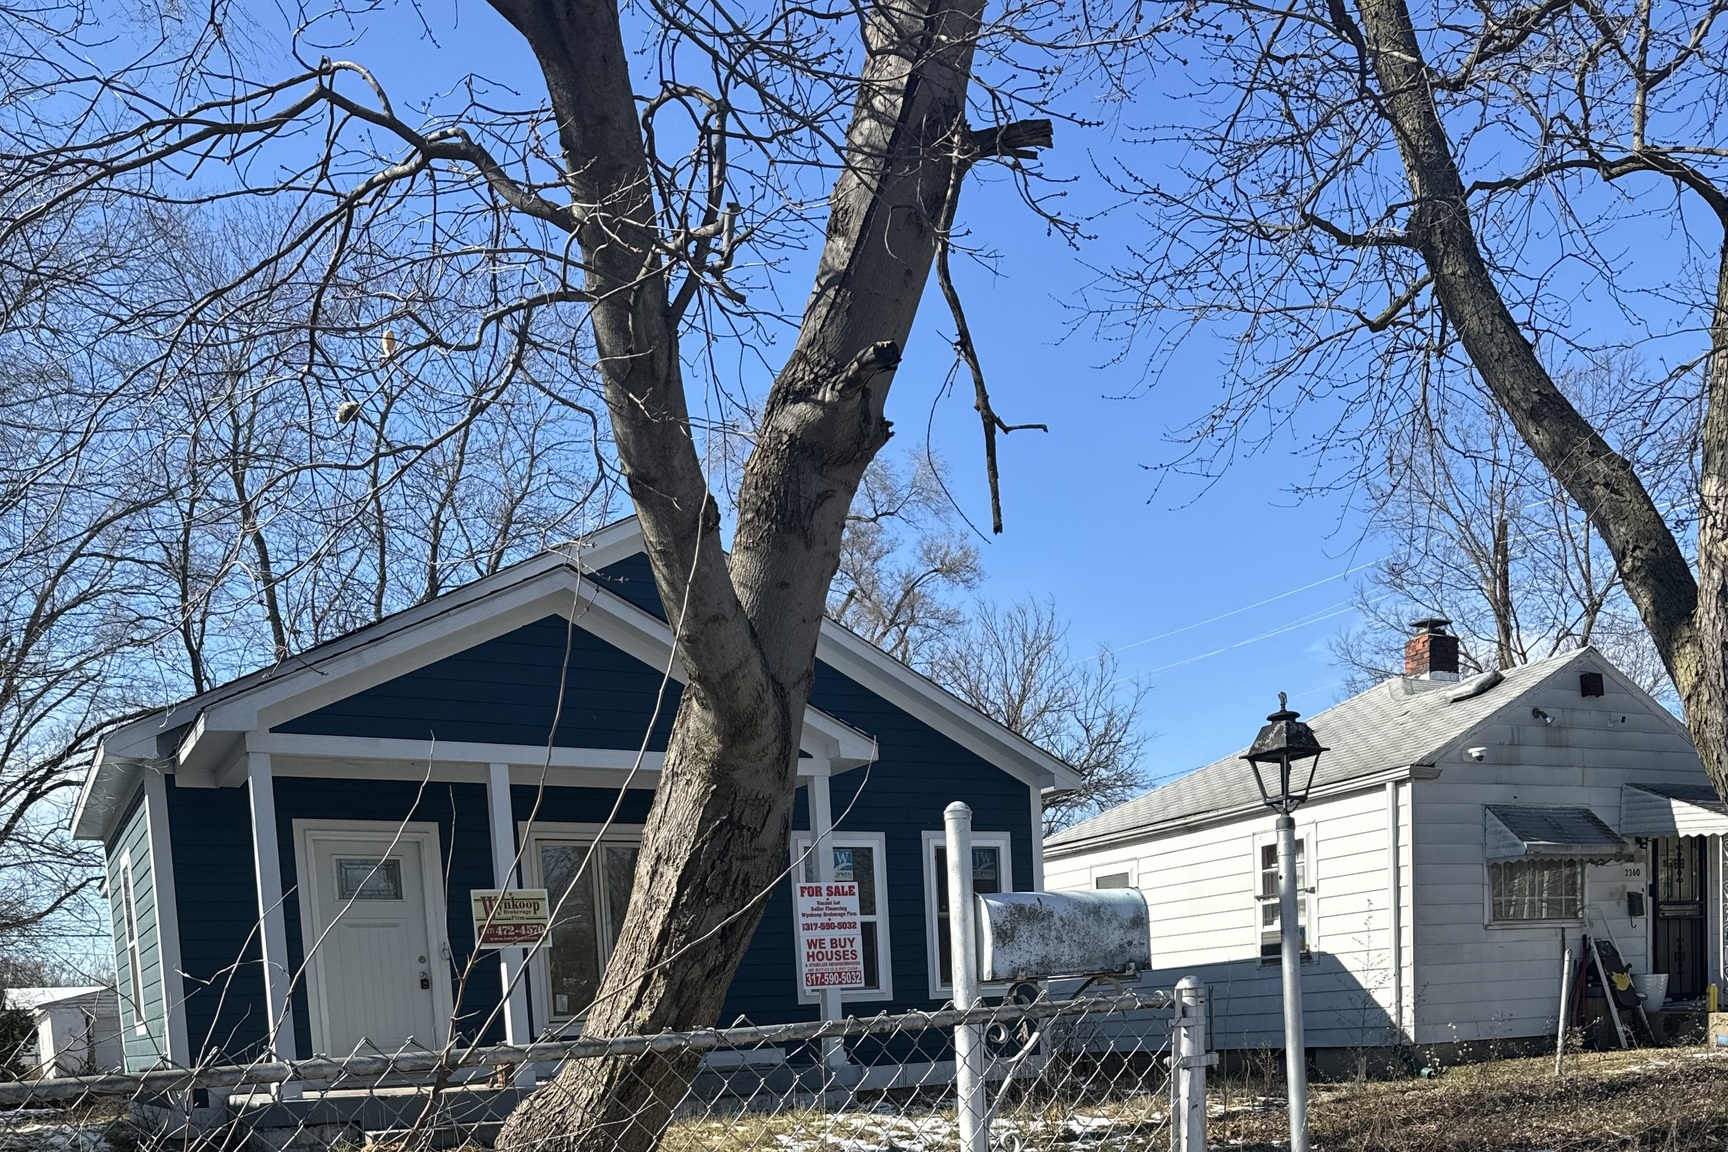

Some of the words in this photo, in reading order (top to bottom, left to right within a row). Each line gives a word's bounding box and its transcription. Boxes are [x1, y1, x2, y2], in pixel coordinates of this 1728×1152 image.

[1625, 868, 1641, 877] 3360
[800, 886, 823, 897] FOR
[826, 885, 856, 897] SALE
[480, 896, 540, 920] Wynkoop
[495, 925, 545, 935] 472-4570
[806, 938, 826, 950] WE
[830, 937, 856, 949] BUY
[806, 950, 858, 962] HOUSES
[806, 972, 861, 985] 317-590-5032
